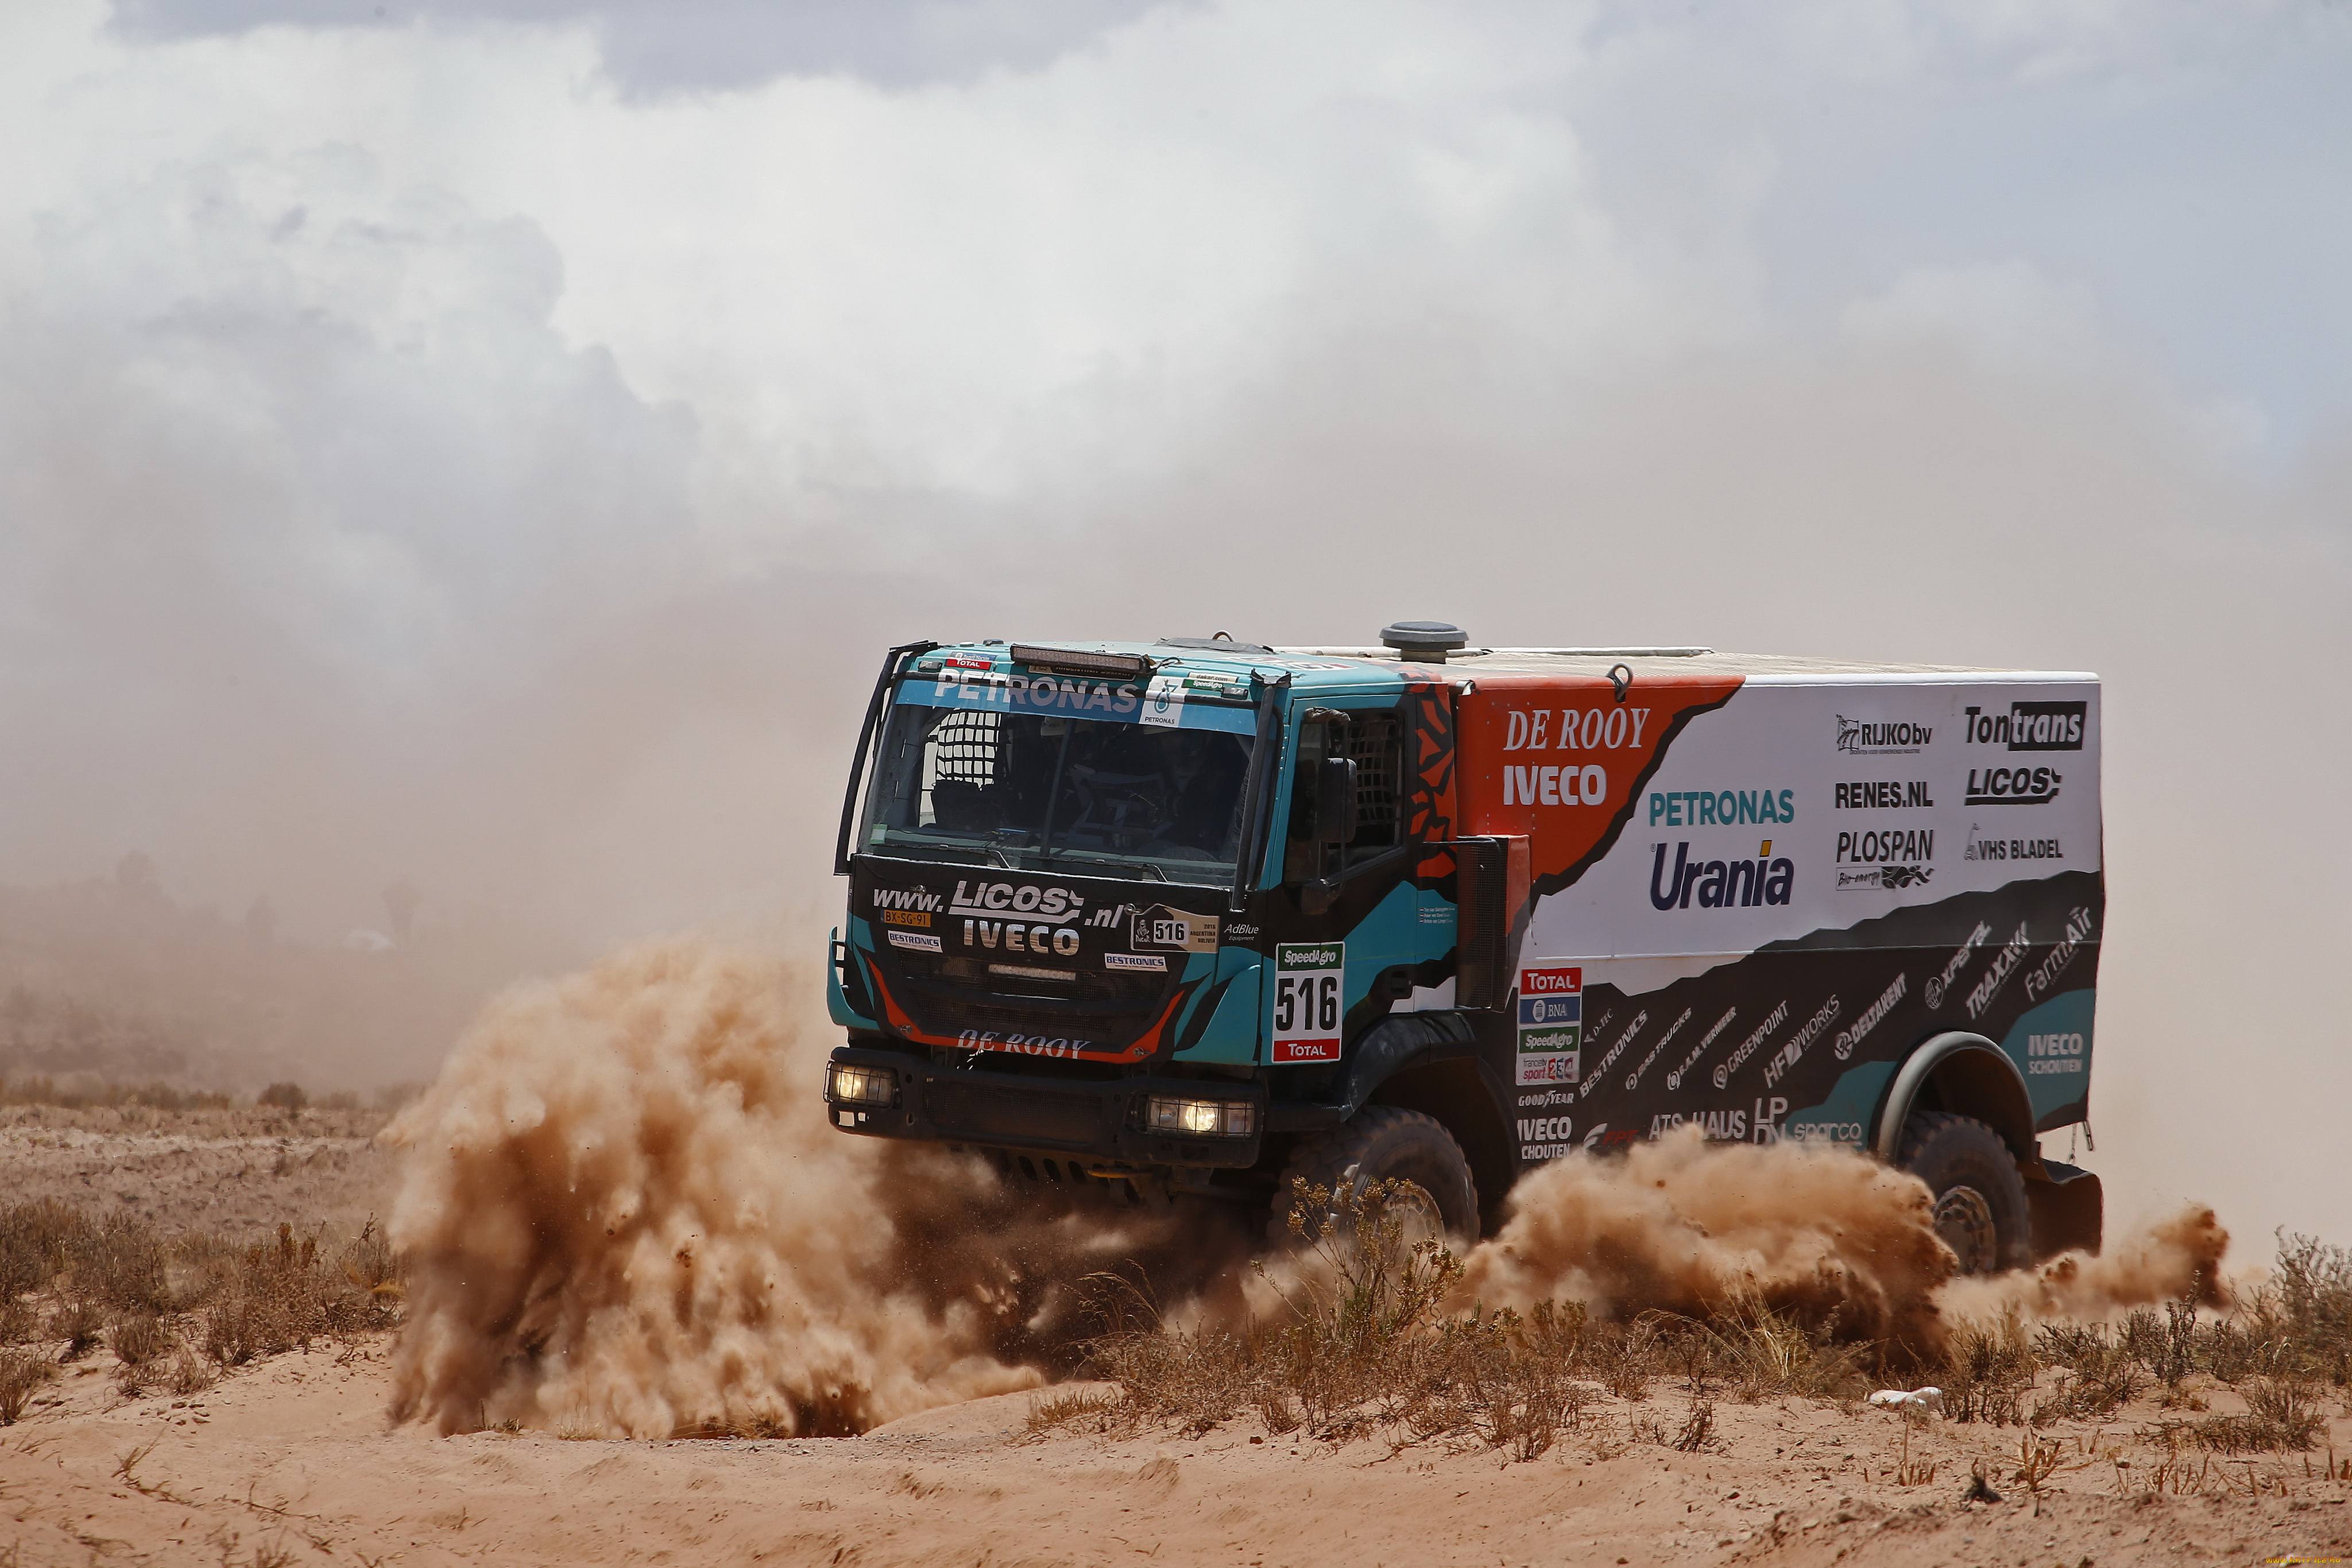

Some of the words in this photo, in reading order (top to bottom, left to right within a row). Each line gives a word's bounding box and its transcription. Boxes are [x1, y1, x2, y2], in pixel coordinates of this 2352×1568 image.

[956, 659, 980, 668] TOTAL
[934, 668, 1140, 714] PETRONAS
[1193, 680, 1223, 688] SpeedAgro
[1144, 716, 1175, 725] PETRONAS
[1503, 709, 1551, 751] DE
[1556, 707, 1651, 750] ROOY
[1503, 764, 1607, 806] IVECO
[1966, 767, 2051, 795] LICOS
[1835, 781, 1934, 808] RENES.NL
[1650, 788, 1795, 827] PETRONAS
[1836, 828, 1935, 862] PLOSPAN
[1978, 839, 2007, 861] VHS
[2010, 838, 2063, 860] BLADEL
[1650, 839, 1795, 911] Urania
[885, 911, 927, 926] BX-SG-91
[1224, 923, 1259, 934] AdBlue
[889, 933, 939, 947] BESTRONICS
[964, 919, 1080, 955] IVECO
[1155, 922, 1185, 941] 516
[1107, 956, 1164, 966] BESTRONICS
[1285, 950, 1337, 966] SpeedAgro
[1275, 976, 1337, 1031] 516
[1548, 1004, 1568, 1017] BNA
[1850, 971, 1908, 1045] DELTARENT
[1798, 994, 1840, 1047] WORKS
[956, 1029, 1000, 1051] DE
[1005, 1033, 1091, 1059] ROOY
[1525, 1032, 1573, 1050] SpeedAgro
[1727, 1000, 1789, 1073] GREENPOINT
[2028, 1033, 2083, 1056] IVECO
[1579, 1009, 1649, 1099] BESTRONICS
[1523, 1066, 1546, 1082] sport
[2028, 1059, 2083, 1074] SCHOUTEN
[1518, 1090, 1575, 1108] GOODYEAR
[1517, 1116, 1572, 1141] IVECO
[1601, 1129, 1639, 1146] FPT
[1794, 1122, 1862, 1143] sparco
[1521, 1143, 1571, 1160] CHOUTEN
